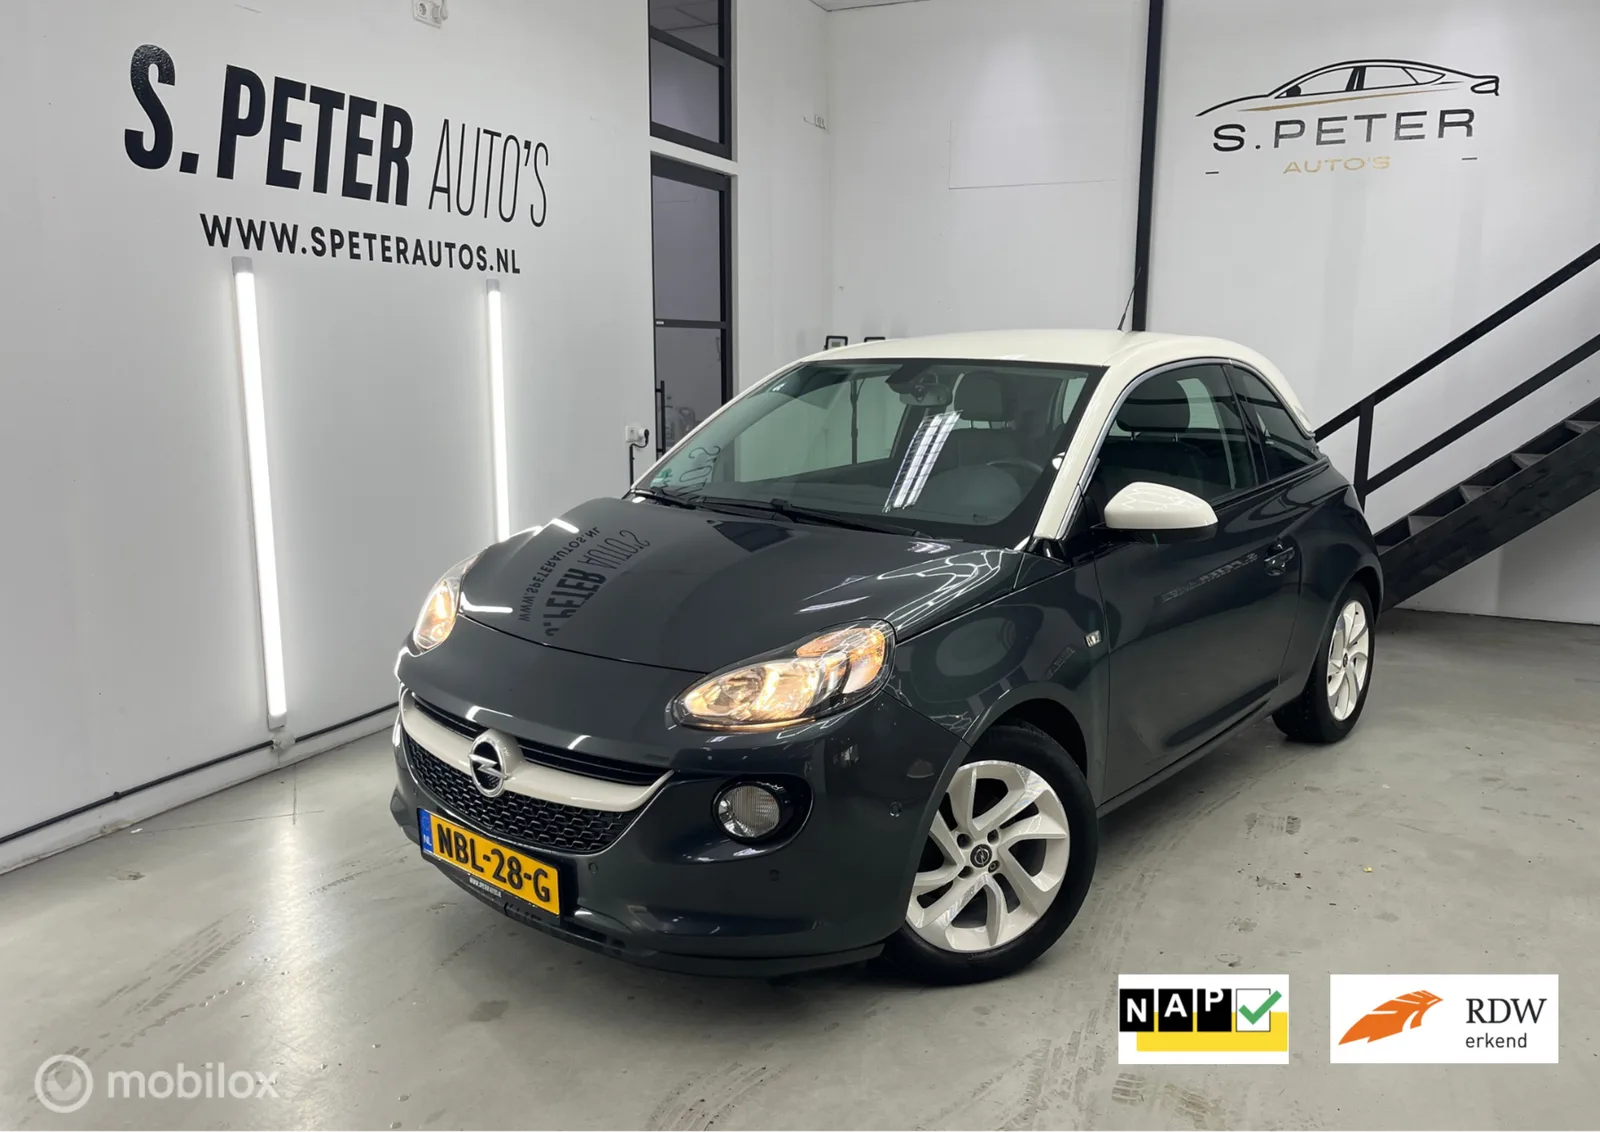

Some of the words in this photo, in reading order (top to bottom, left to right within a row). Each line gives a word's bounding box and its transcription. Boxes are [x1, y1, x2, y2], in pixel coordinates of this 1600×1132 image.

[216, 63, 414, 206] PETER
[428, 118, 550, 228] AUTO'S
[1282, 155, 1391, 175] AUTO'S
[199, 212, 522, 275] WWW.SPETERAUTOS.NL
[423, 833, 433, 847] NL
[436, 822, 551, 903] NBL-28-G
